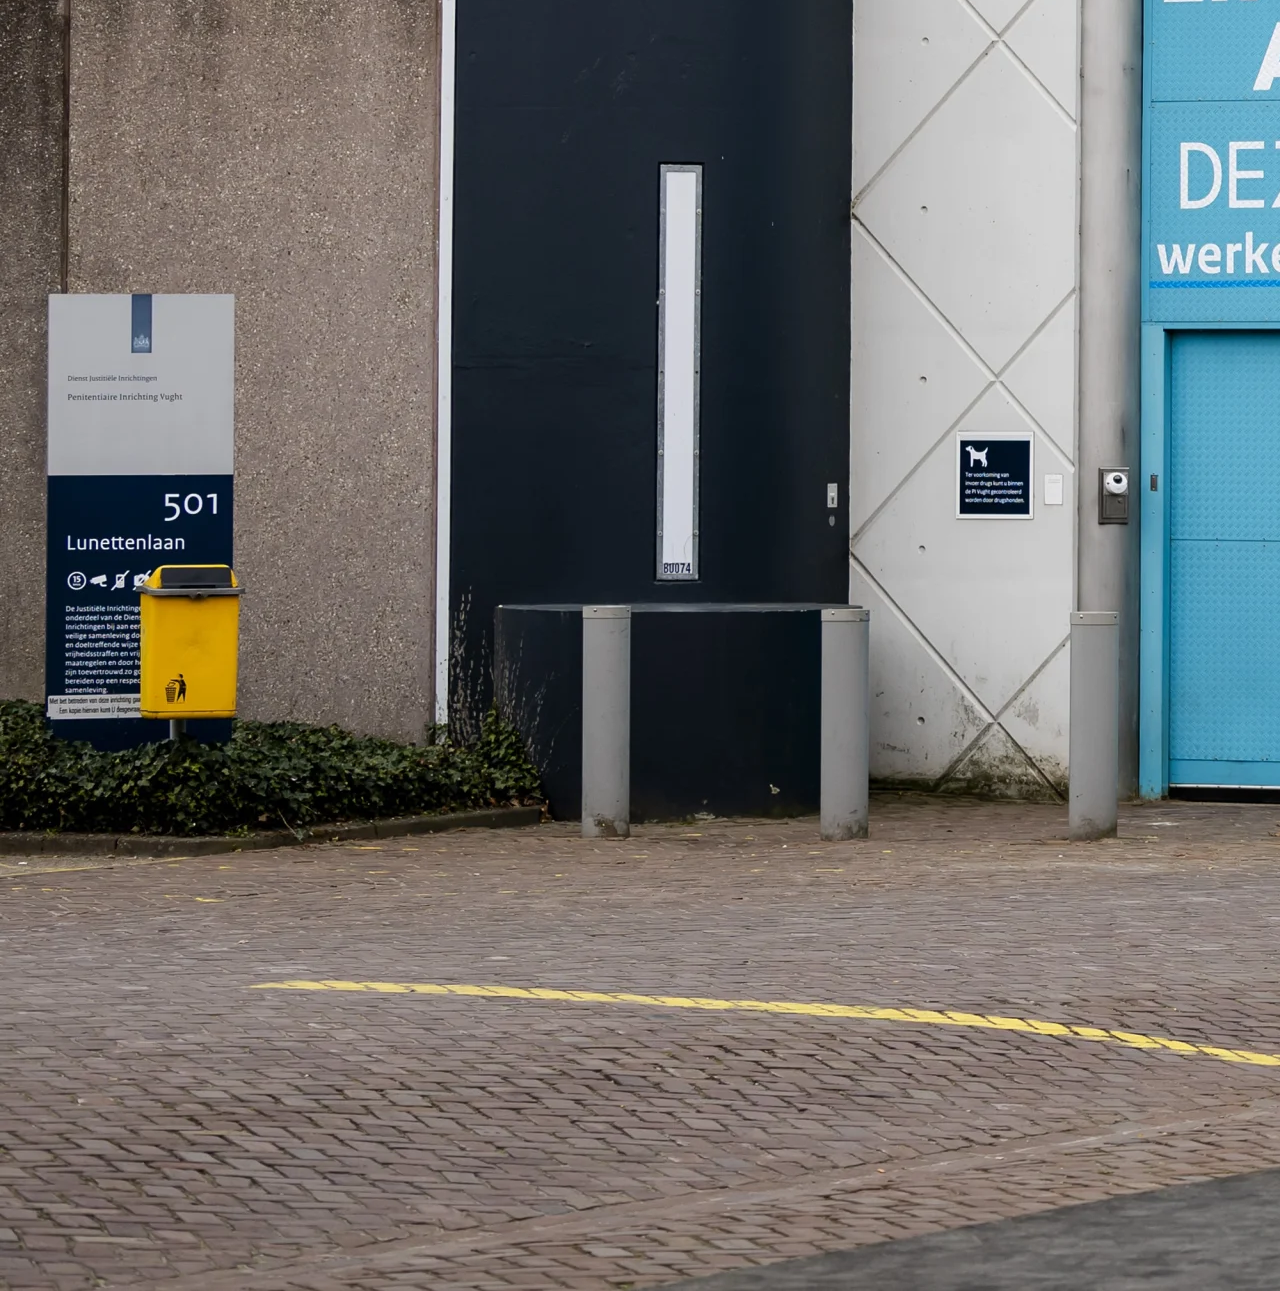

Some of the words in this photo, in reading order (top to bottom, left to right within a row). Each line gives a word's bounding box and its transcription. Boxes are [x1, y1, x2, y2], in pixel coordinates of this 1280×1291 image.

[118, 374, 158, 383] Inrichtingen
[119, 393, 158, 402] Inrichting
[160, 392, 182, 402] Vught
[164, 493, 218, 521] 501
[67, 534, 185, 550] Lunettenlaan
[664, 563, 691, 573] BU074
